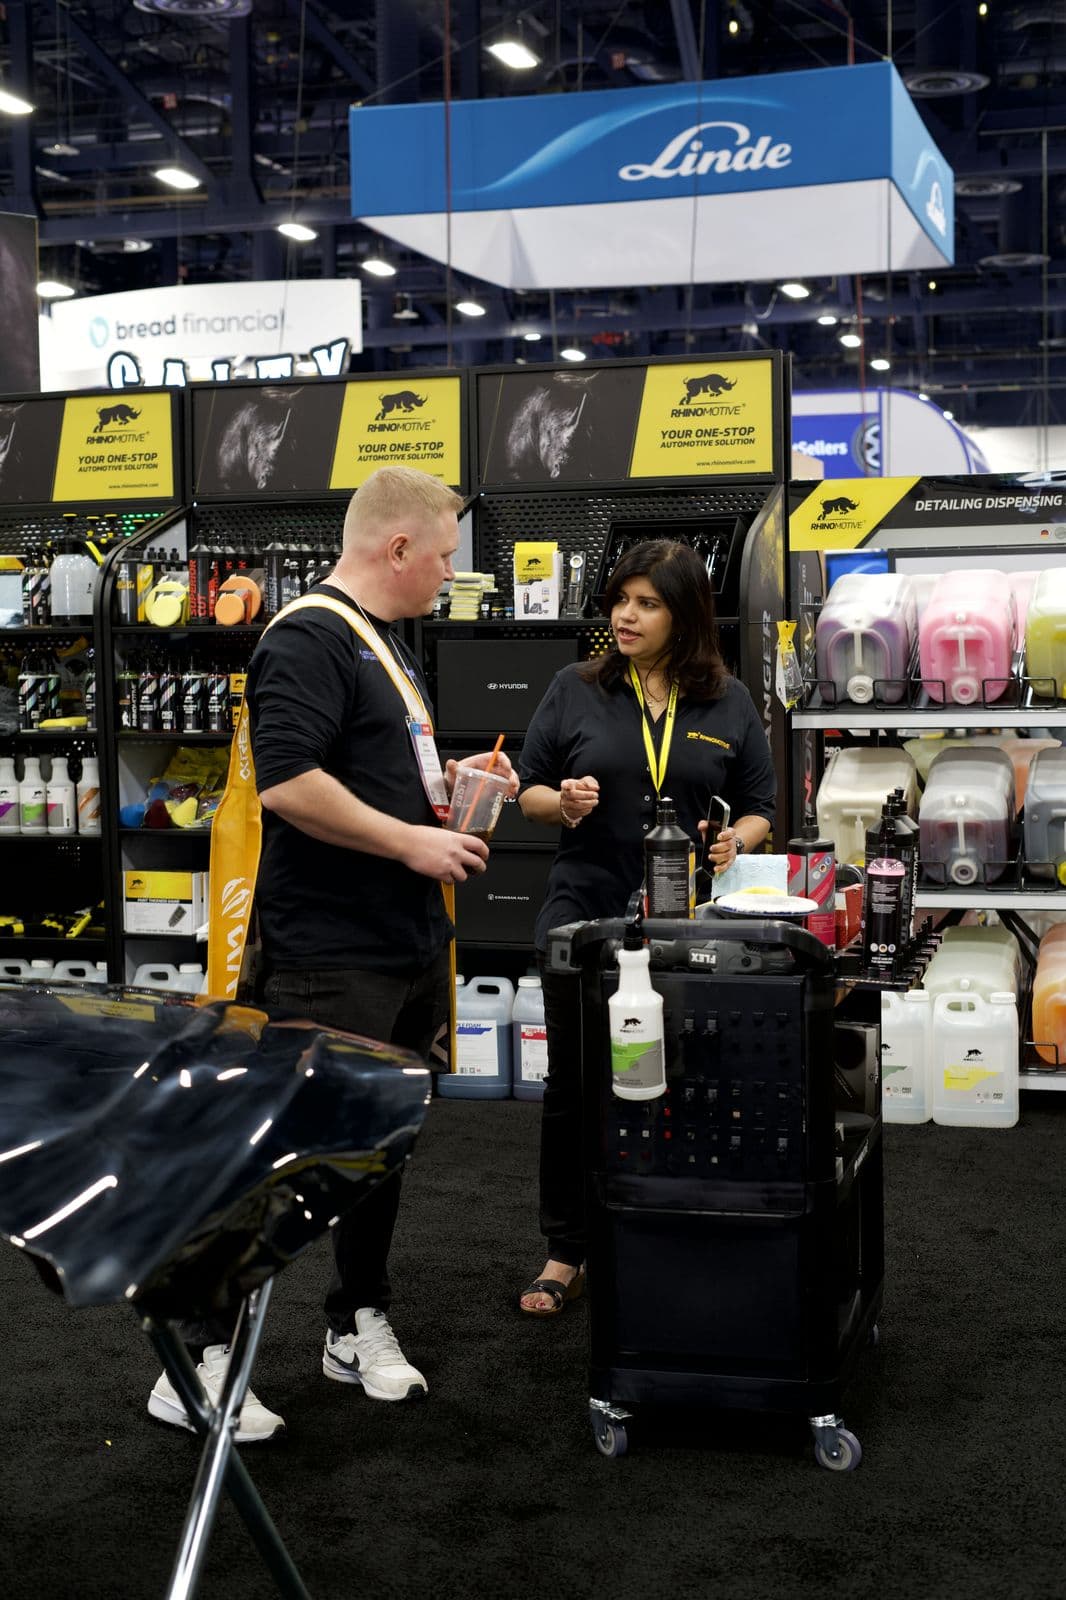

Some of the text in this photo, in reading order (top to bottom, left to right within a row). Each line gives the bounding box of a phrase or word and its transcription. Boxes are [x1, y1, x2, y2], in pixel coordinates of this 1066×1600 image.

[618, 120, 792, 182] Linde
[116, 309, 284, 340] bread financial
[671, 406, 741, 418] RHINOMOTIVE
[367, 421, 431, 433] RHINOMOTIVE
[660, 426, 755, 440] YOUR ONE-STOP
[86, 433, 145, 445] RHINOMOTIVE
[660, 438, 755, 449] AUTOMOTIVE SOLUTION
[358, 441, 444, 453] YOUR ONE-STOP
[78, 452, 158, 465] YOUR ONE-STOP
[357, 452, 444, 462] AUTOMOTIVE SOLUTION
[78, 463, 158, 473] AUTOMOTIVE SOLUTION
[914, 495, 1062, 512] DETAILING DISPENSING
[810, 521, 863, 530] RHINOMOTIVE
[189, 559, 197, 617] SUPERIOR
[197, 593, 207, 617] CUT
[691, 952, 716, 964] FLEX
